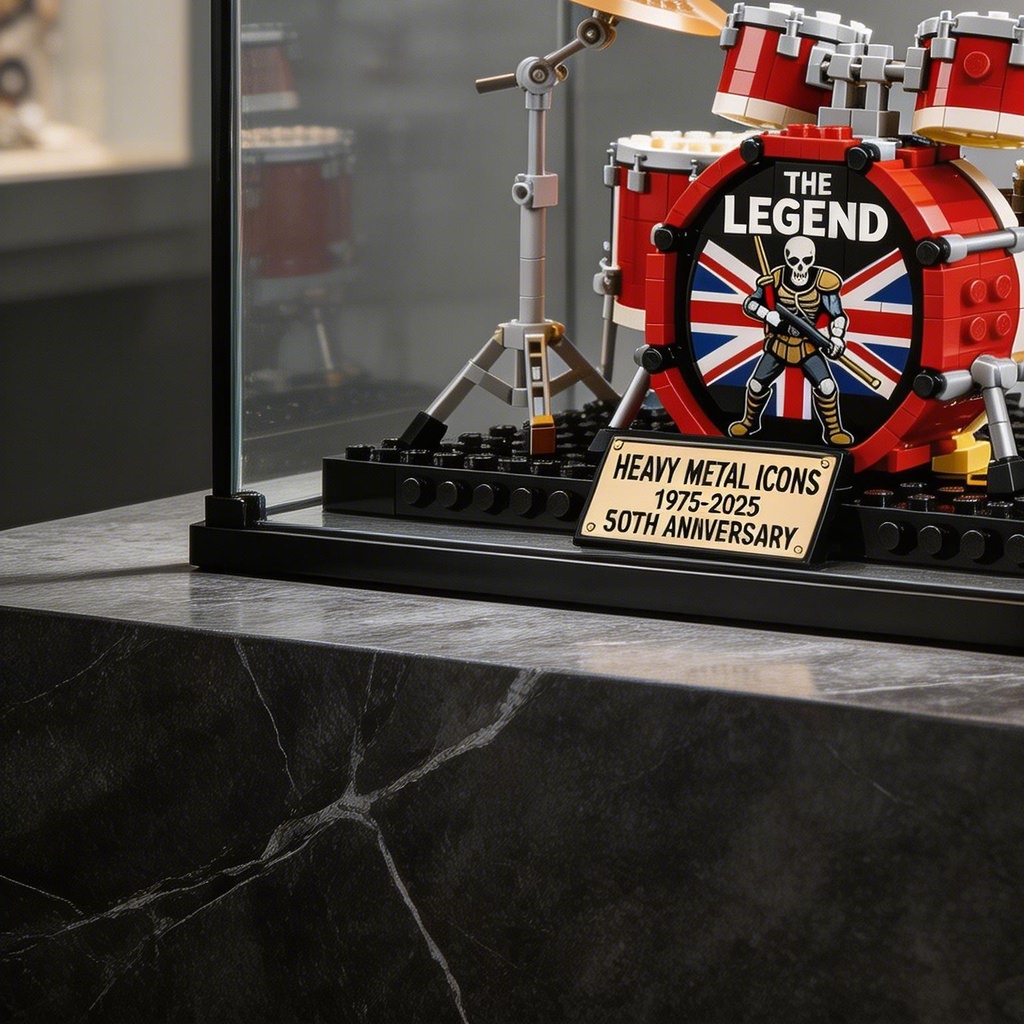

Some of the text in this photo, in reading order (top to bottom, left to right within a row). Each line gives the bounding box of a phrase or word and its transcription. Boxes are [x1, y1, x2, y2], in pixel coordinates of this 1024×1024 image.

[783, 171, 832, 196] THE
[723, 194, 889, 242] LEGEND
[612, 453, 822, 496] HEAVY METAL ICONS
[655, 488, 761, 517] 1975-2025
[602, 508, 660, 536] 50TH
